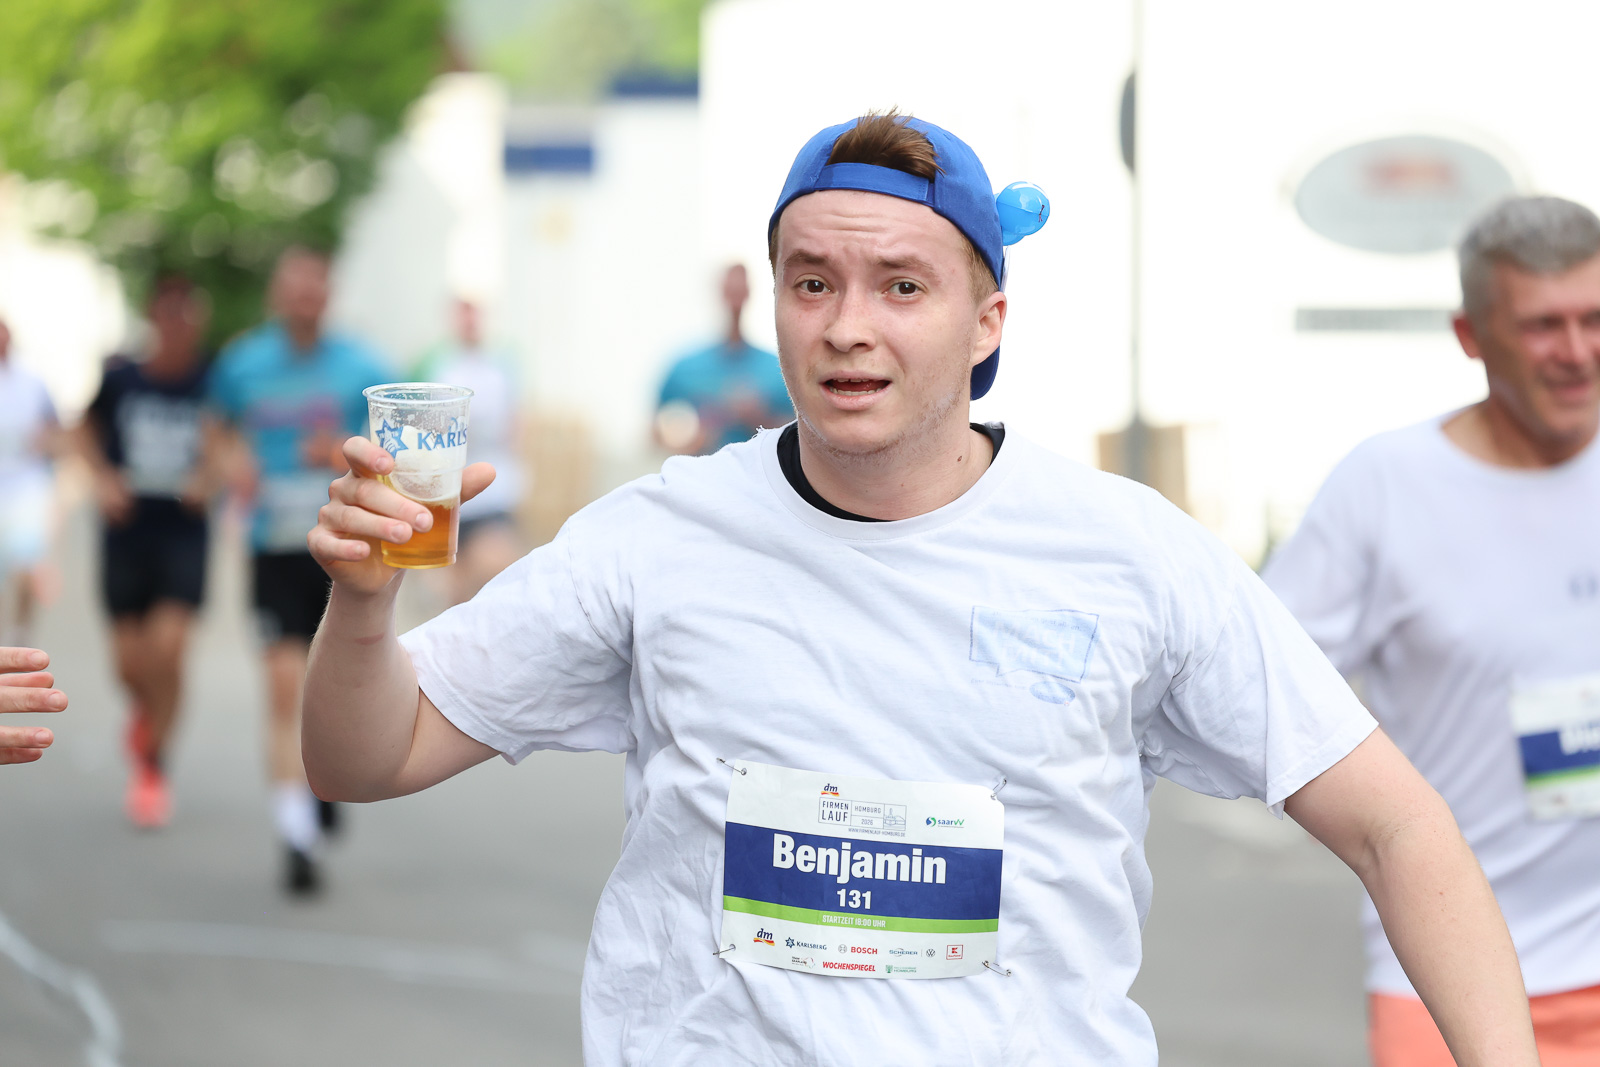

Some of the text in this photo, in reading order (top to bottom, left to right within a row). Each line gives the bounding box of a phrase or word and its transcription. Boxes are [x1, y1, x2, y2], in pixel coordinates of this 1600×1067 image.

[823, 783, 838, 793] dm
[822, 800, 849, 810] FIRMEN
[854, 805, 882, 814] HOMBURG
[821, 810, 849, 822] LAUF
[772, 833, 947, 884] Benjamin
[836, 888, 872, 910] 131
[822, 914, 886, 928] STARTZEIT 18:00 UHR
[756, 928, 773, 940] dm
[796, 941, 828, 951] KARLSBERG
[850, 946, 878, 955] BOSCH
[822, 961, 876, 972] WOCHENSPIEGEL
